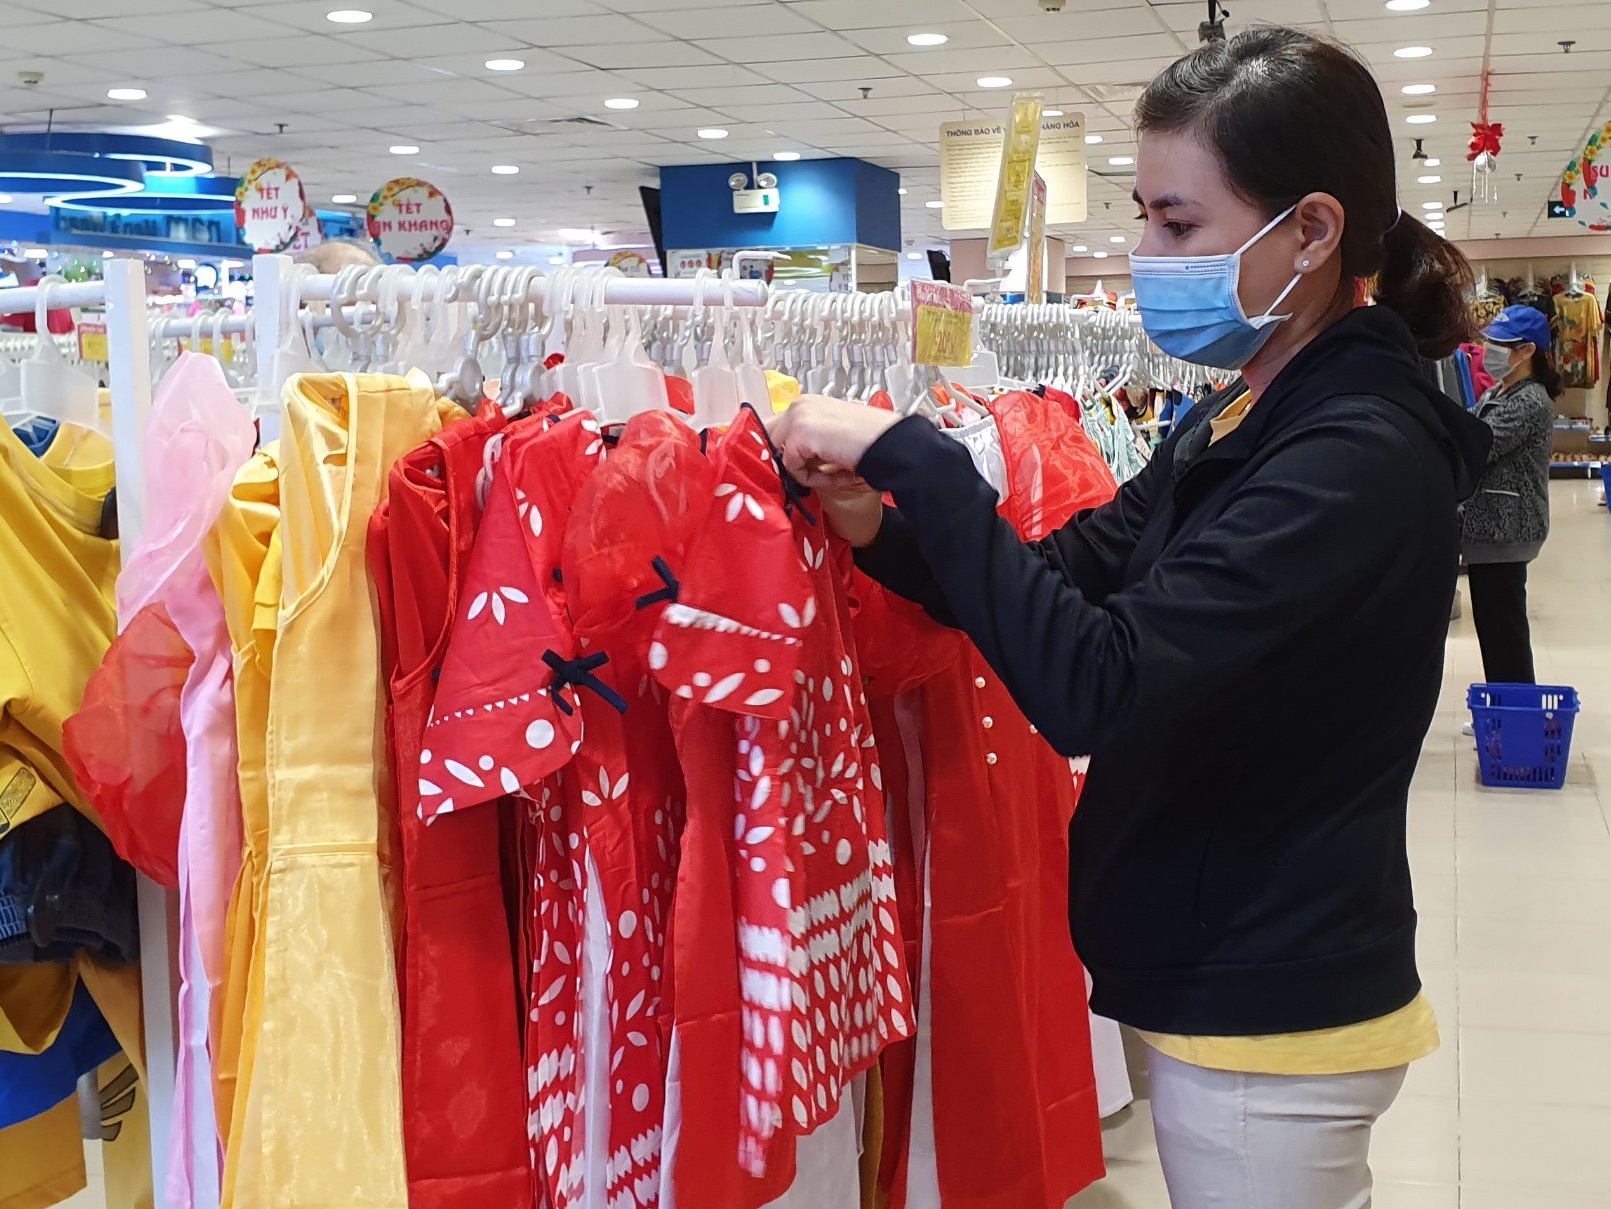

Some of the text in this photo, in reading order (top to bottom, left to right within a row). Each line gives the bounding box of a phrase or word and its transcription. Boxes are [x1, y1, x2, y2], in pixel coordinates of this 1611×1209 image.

[946, 128, 973, 137] THÔNG
[1590, 164, 1611, 180] SU
[397, 219, 449, 233] KHANG
